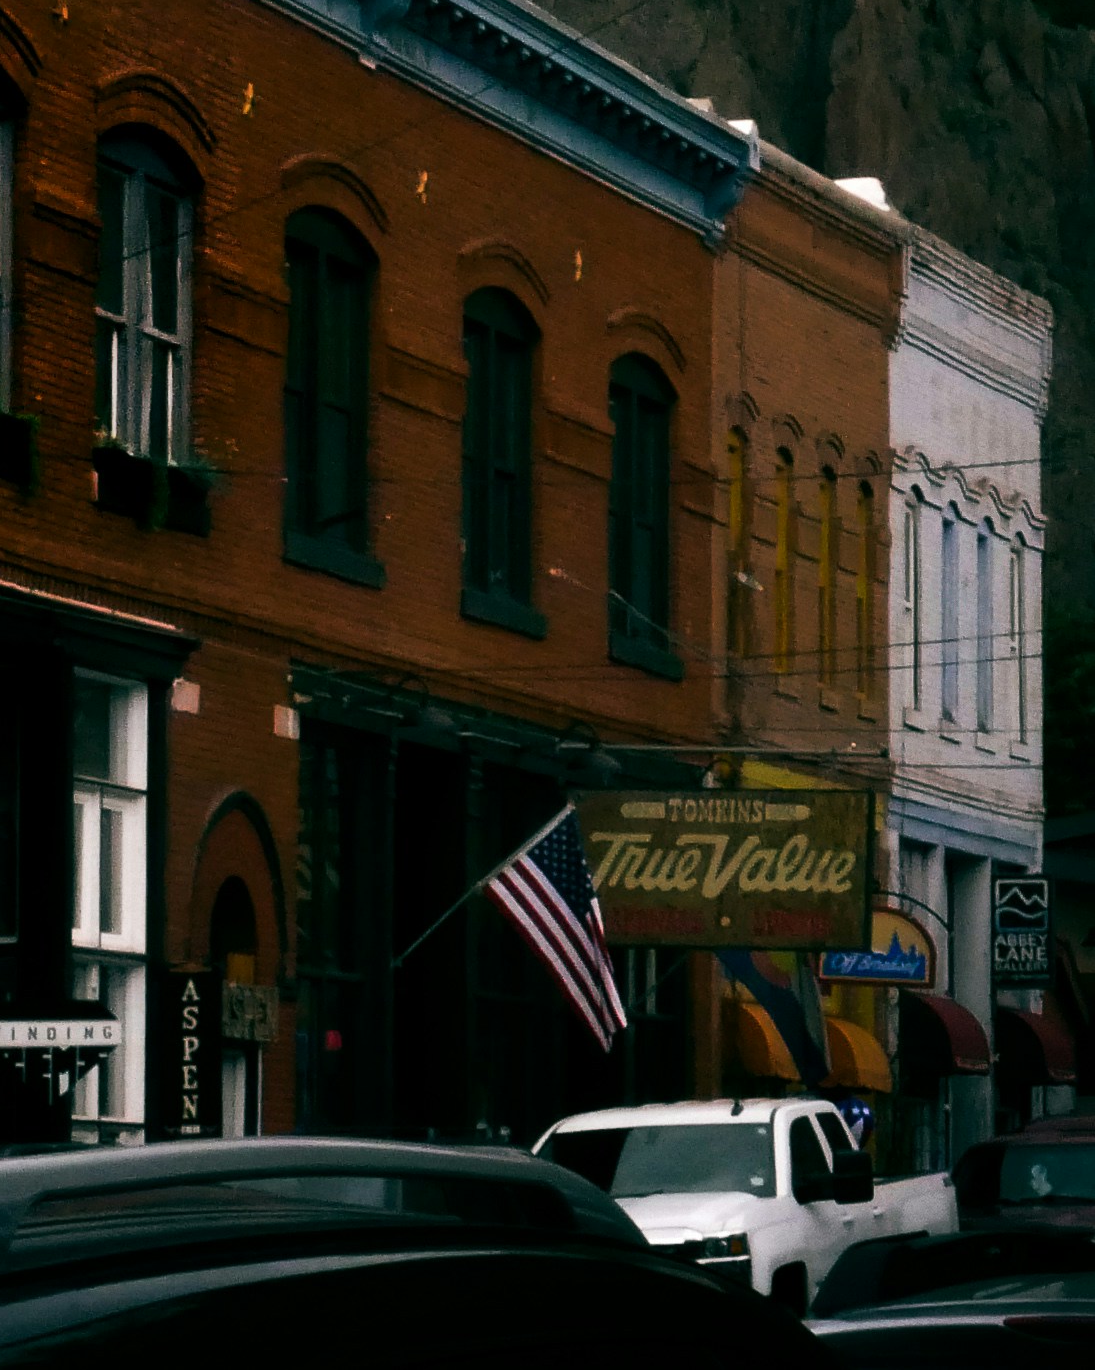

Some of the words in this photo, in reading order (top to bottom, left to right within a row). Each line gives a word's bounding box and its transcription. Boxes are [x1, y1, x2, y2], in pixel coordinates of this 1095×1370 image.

[667, 798, 765, 822] TOMKINS
[994, 946, 1048, 962] LANE
[180, 977, 202, 1120] ASPEN
